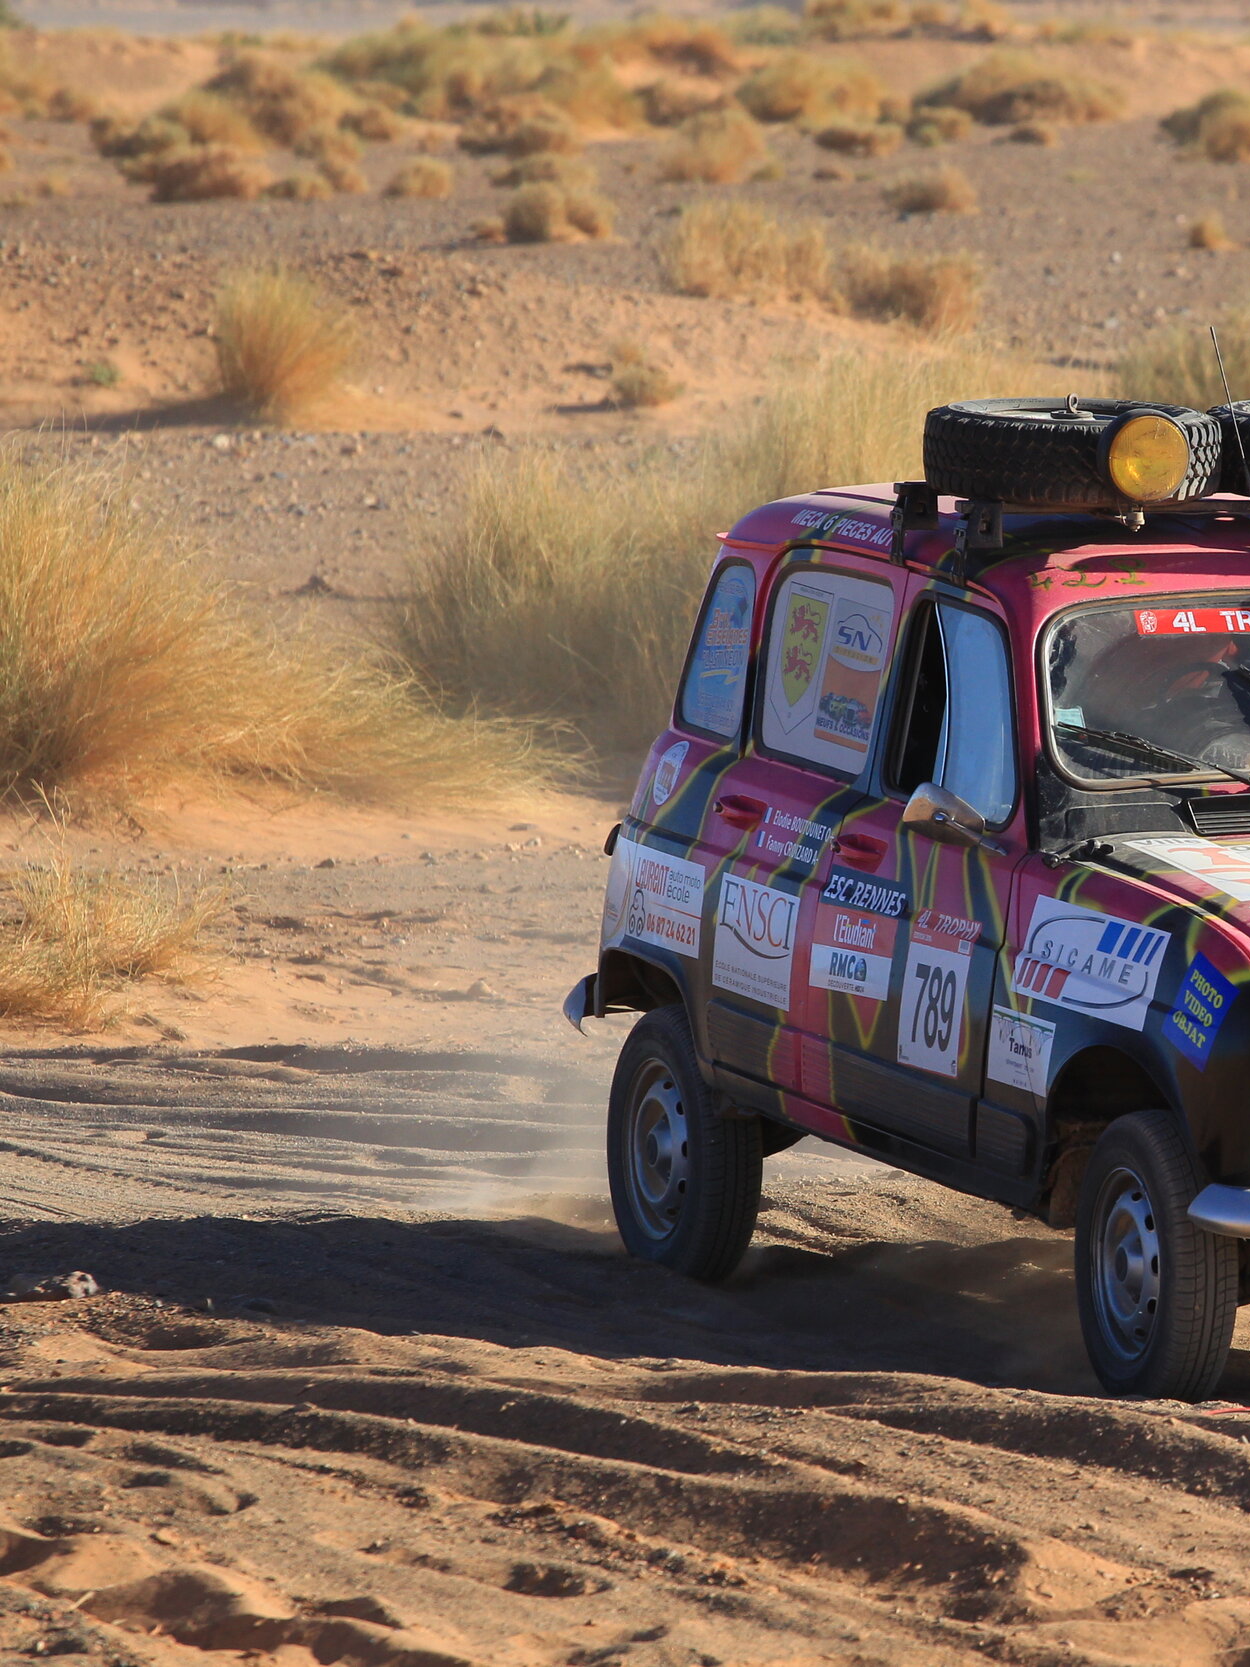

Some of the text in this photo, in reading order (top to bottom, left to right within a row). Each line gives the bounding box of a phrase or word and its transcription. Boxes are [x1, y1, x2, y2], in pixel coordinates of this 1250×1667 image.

[791, 508, 826, 530] MECA
[831, 518, 876, 540] PIECES
[1171, 610, 1207, 633] 4L
[836, 625, 872, 652] SN
[815, 716, 834, 731] NEUFS
[838, 723, 870, 742] OCCASIONS
[772, 809, 792, 830] Elodie
[790, 815, 827, 841] BOUTOUNET
[766, 834, 785, 857] Fanny
[783, 840, 813, 863] CROIZARD
[666, 881, 691, 903] école
[669, 869, 701, 889] auto moto
[823, 874, 906, 917] ESC RENNES
[646, 913, 696, 946] 06 87 24 62 21
[720, 880, 796, 950] ENSCI
[917, 909, 934, 929] 4L
[933, 913, 982, 941] TROPHY
[828, 952, 856, 980] RMC
[1041, 940, 1134, 985] SICAME
[1189, 968, 1224, 1009] PHOTO
[911, 963, 957, 1053] 789
[1183, 989, 1213, 1028] VIDEO
[1172, 1010, 1206, 1049] OBJAT
